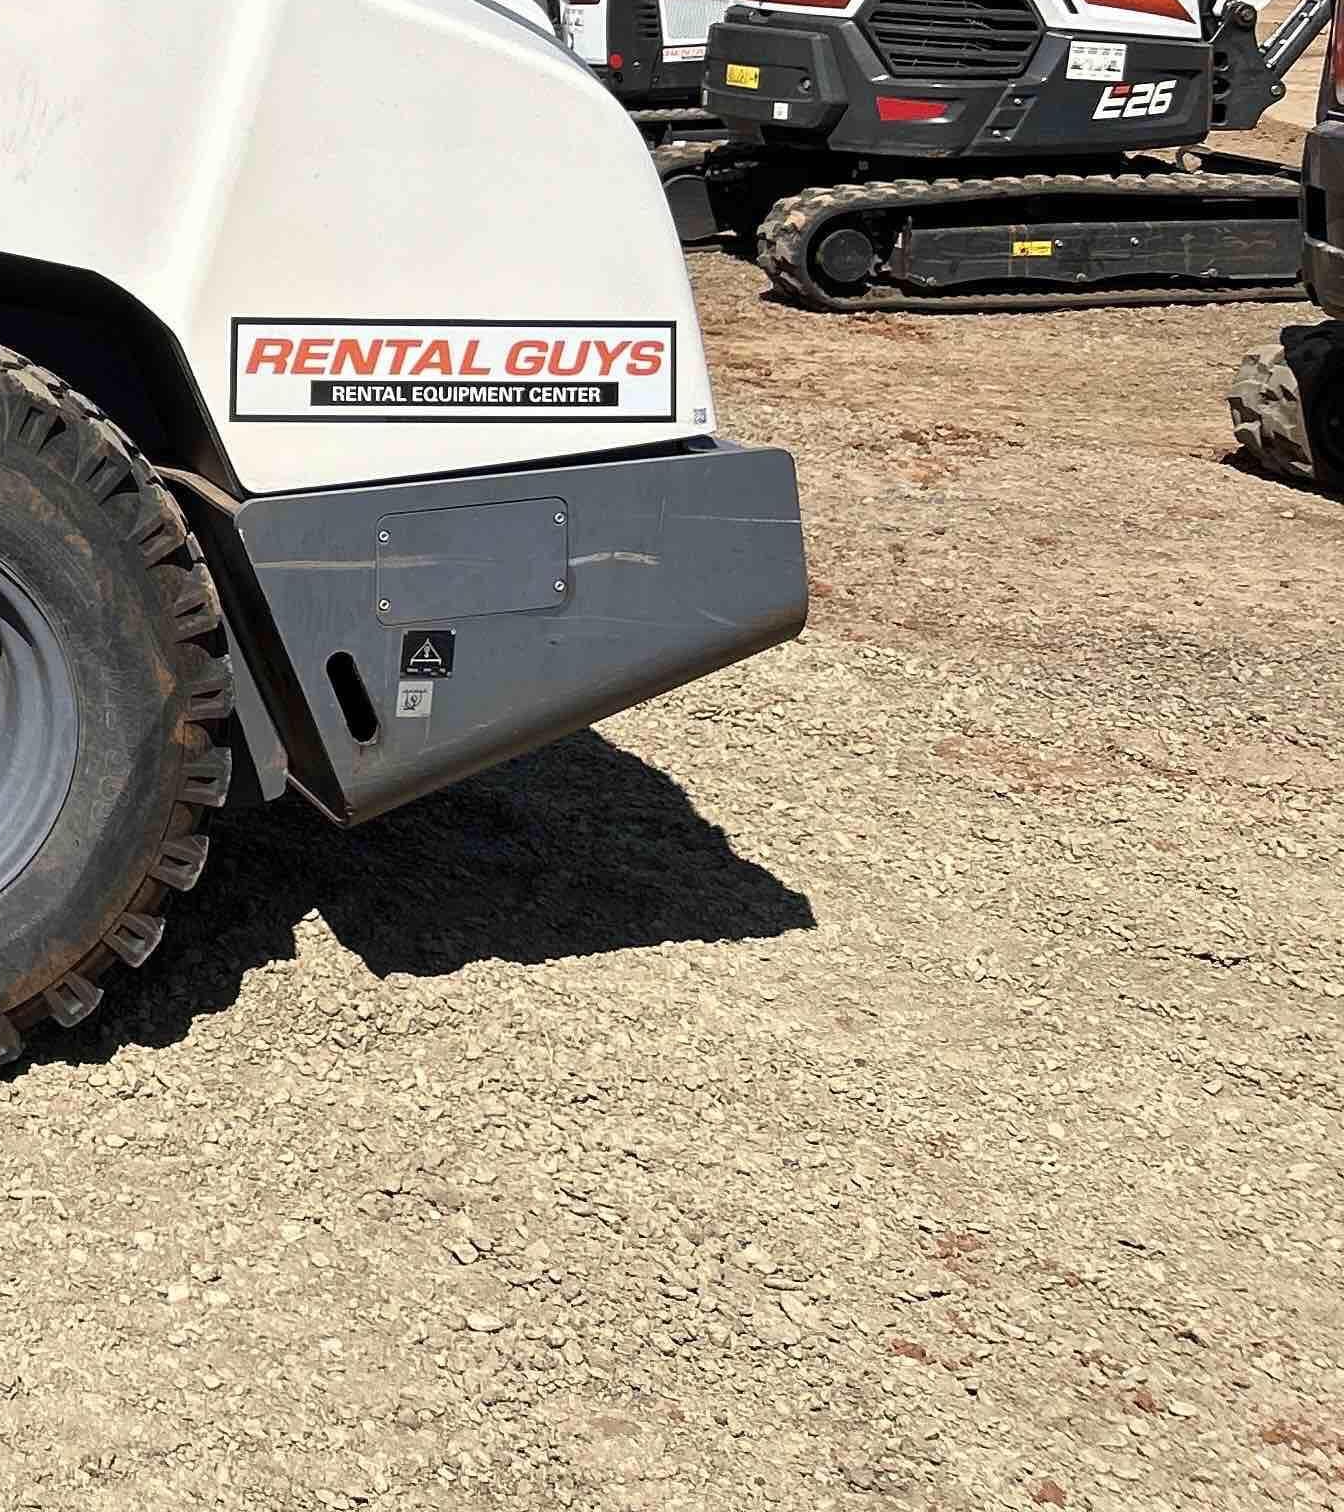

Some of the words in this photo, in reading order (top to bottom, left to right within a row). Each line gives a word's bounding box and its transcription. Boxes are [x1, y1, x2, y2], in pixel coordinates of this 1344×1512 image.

[1092, 79, 1177, 119] E26
[245, 337, 494, 376] RENTAL
[503, 339, 665, 377] GUYS
[331, 386, 407, 402] RENTAL
[412, 386, 525, 403] EQUIPMENT
[528, 387, 602, 404] CENTER
